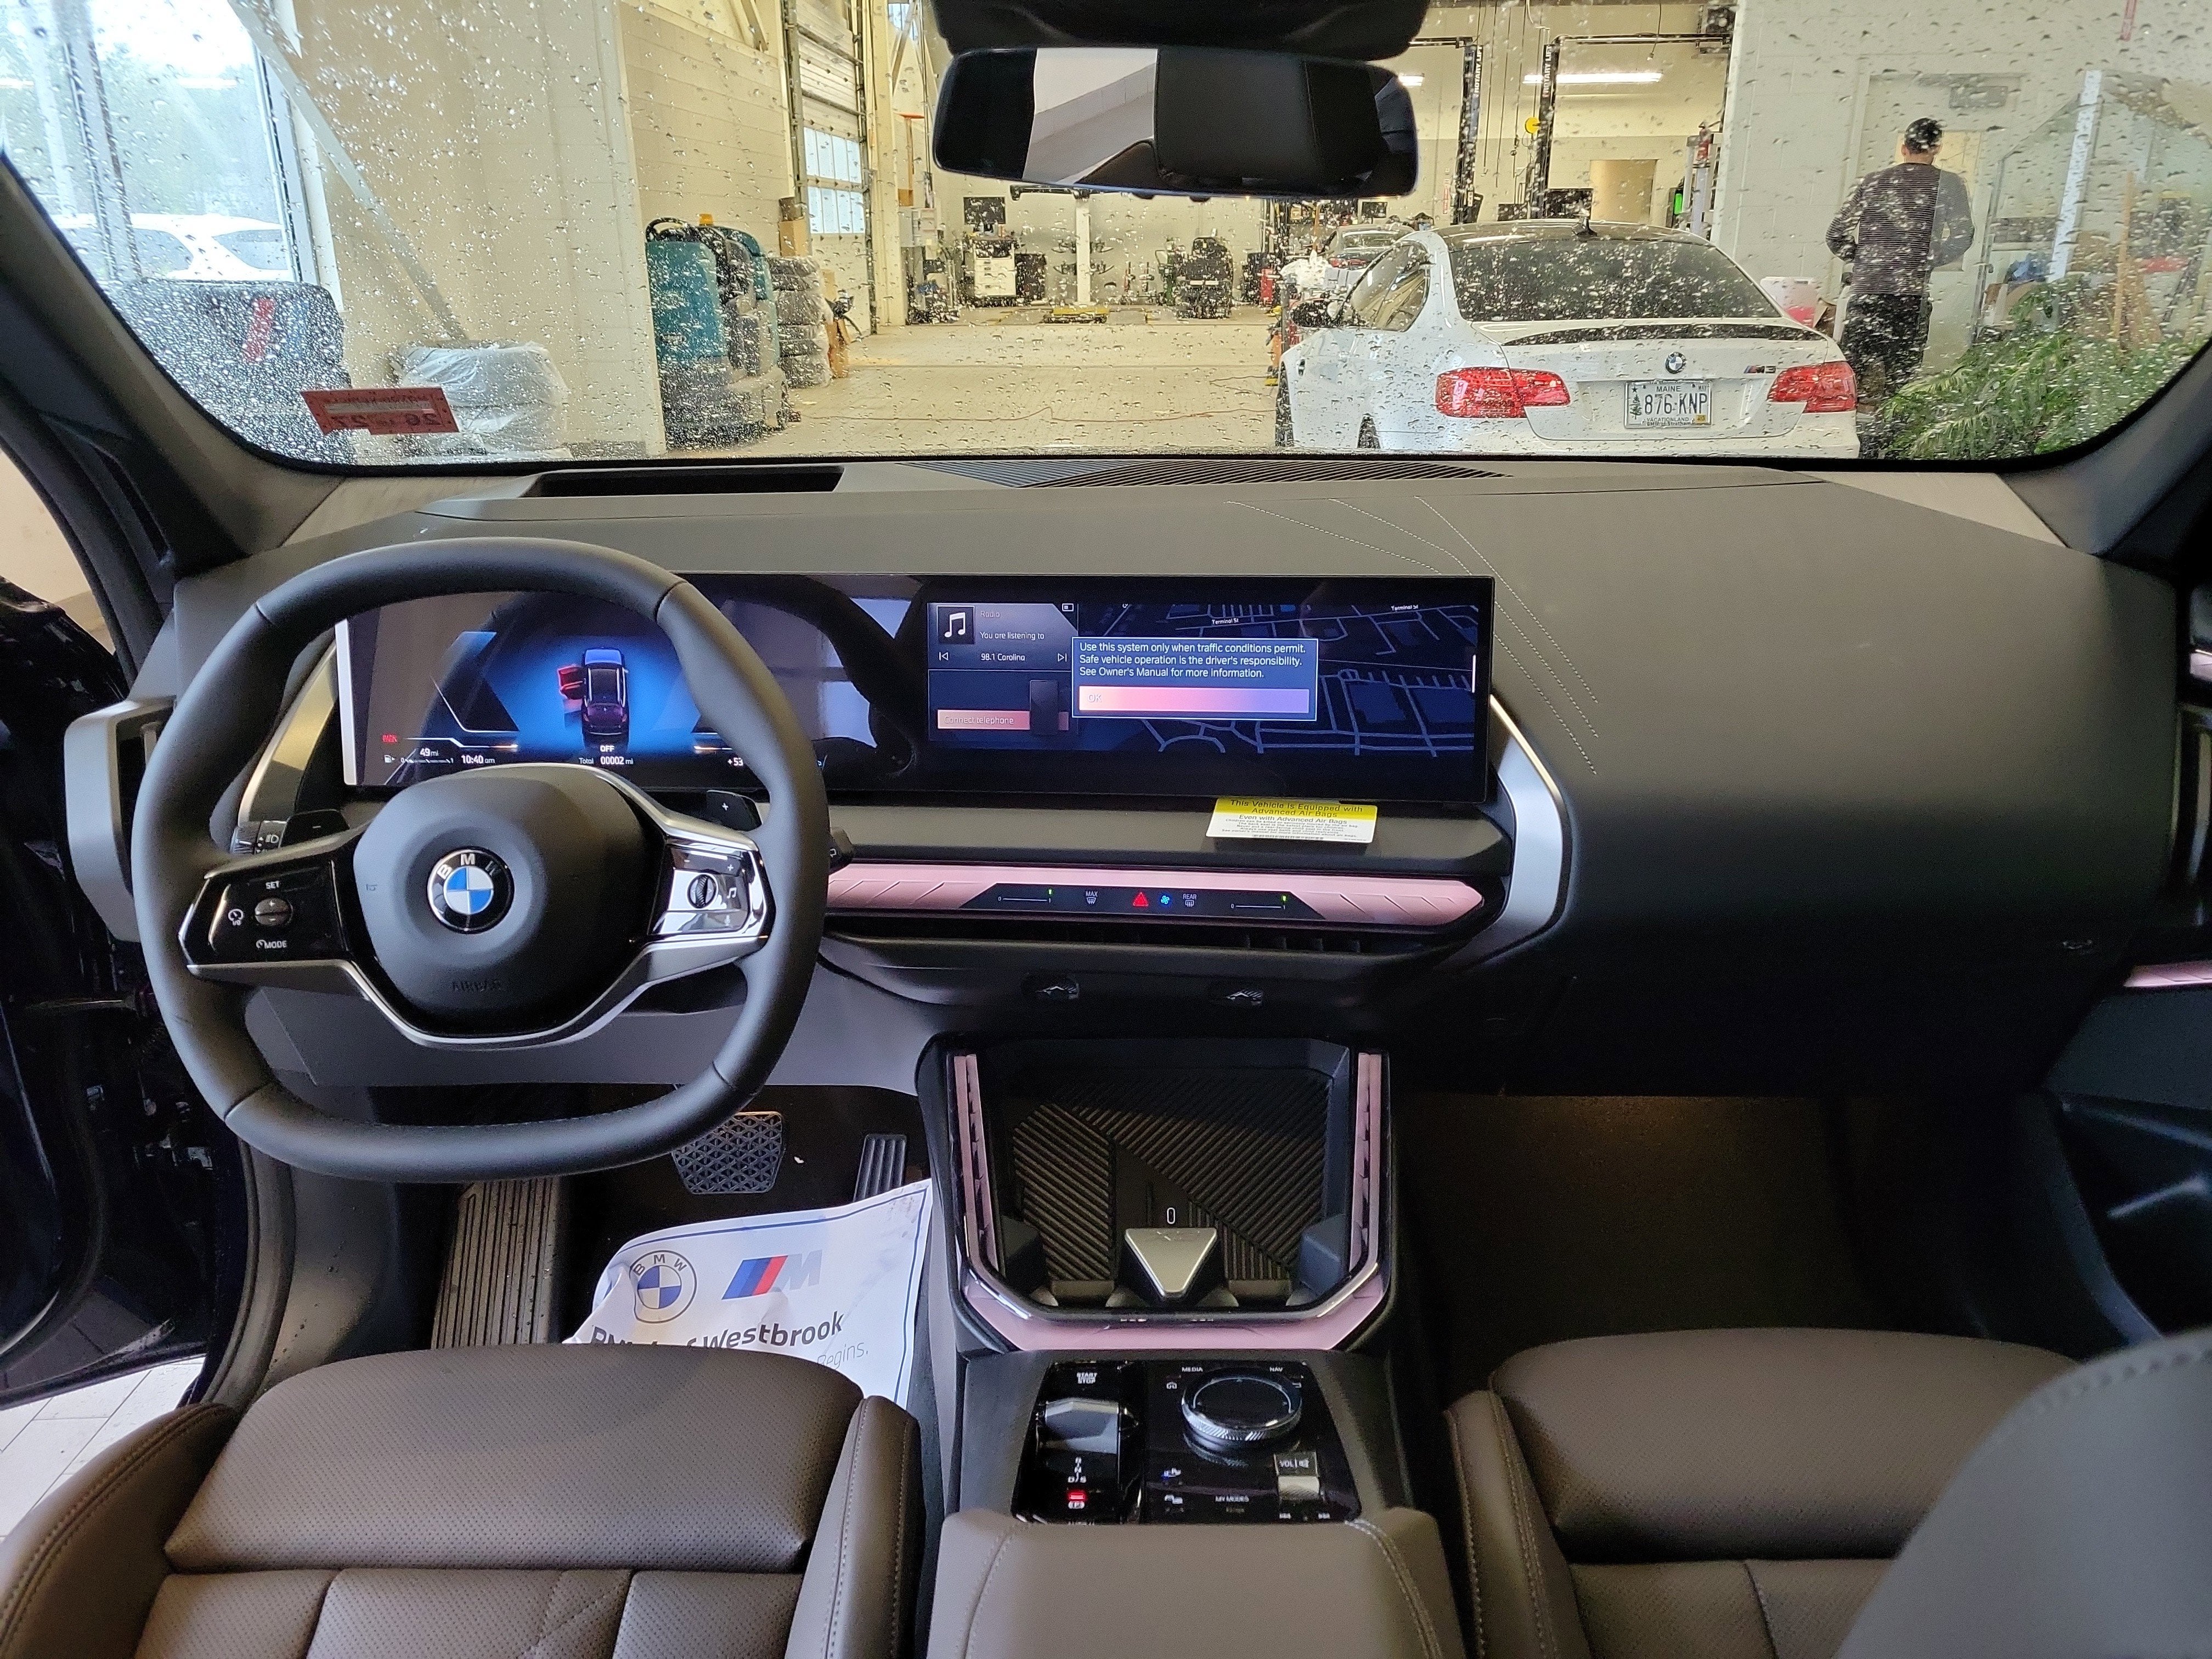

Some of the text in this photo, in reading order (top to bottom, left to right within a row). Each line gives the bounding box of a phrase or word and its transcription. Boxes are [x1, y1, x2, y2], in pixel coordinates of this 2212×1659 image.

[1007, 632, 1036, 640] listening
[1080, 642, 1306, 654] Use this system only when traffic conditions permit.
[1079, 654, 1302, 667] Safe vehicle operation is the driver's responsibility.
[1079, 667, 1096, 676] See
[1098, 667, 1134, 676] Owner's
[1136, 667, 1168, 676] Manual
[1170, 668, 1183, 677] for
[1211, 669, 1264, 678] information.
[1087, 693, 1102, 703] OK
[944, 715, 1014, 725] Connect telephone
[420, 748, 430, 757] 49
[461, 755, 484, 764] 10:40
[600, 757, 624, 765] 00002
[1298, 804, 1341, 812] Equipped
[266, 881, 280, 889] SET
[264, 940, 287, 949] MODE
[633, 1254, 687, 1277] BMW
[703, 1311, 844, 1349] Westbrook
